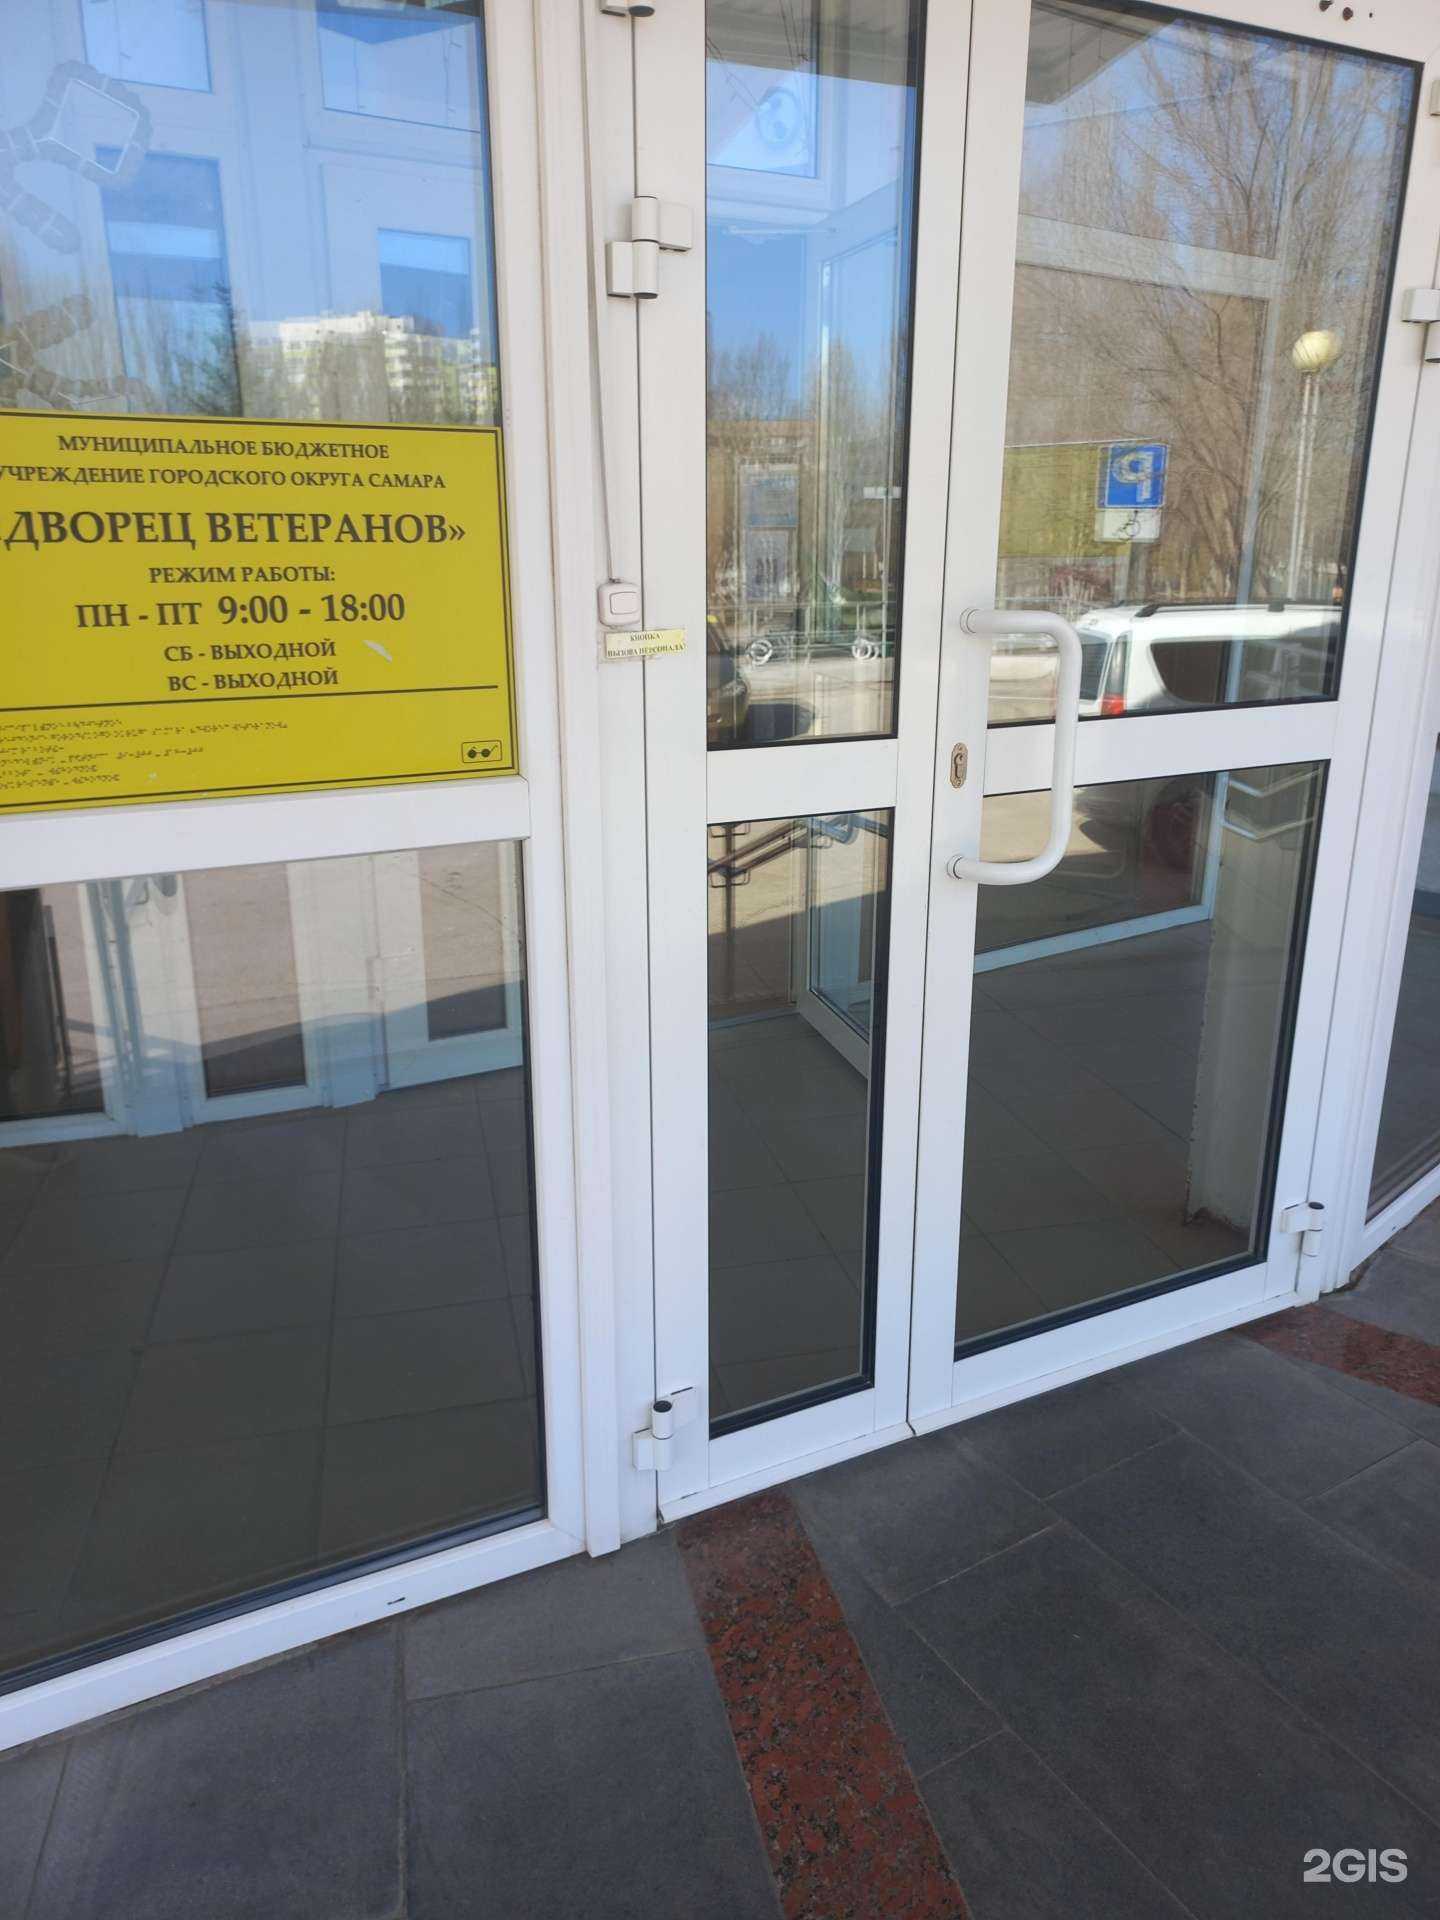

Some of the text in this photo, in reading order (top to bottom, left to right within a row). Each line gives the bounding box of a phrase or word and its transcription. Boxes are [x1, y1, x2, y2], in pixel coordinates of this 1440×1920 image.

[57, 435, 389, 459] МУНИЦИПАЛЬНОЕ БЮДЖЕТНОЕ
[150, 469, 286, 487] ГОРОДСКОГО
[291, 471, 364, 487] ОКРУГА
[368, 473, 446, 489] САМАРА
[0, 511, 466, 551] ДВОРЕЦ ВЕТЕРАНОВ»
[149, 566, 336, 584] РЕЖИМ РАБОТЫ:
[75, 603, 130, 628] ПН
[157, 602, 202, 625] ПТ
[217, 595, 289, 625] 9:00
[321, 593, 406, 622] 18:00
[164, 646, 193, 662] СБ
[211, 641, 337, 662] ВЫХОДНОЙ
[168, 675, 197, 692] ВС
[214, 669, 339, 690] ВЫХОДНОЙ
